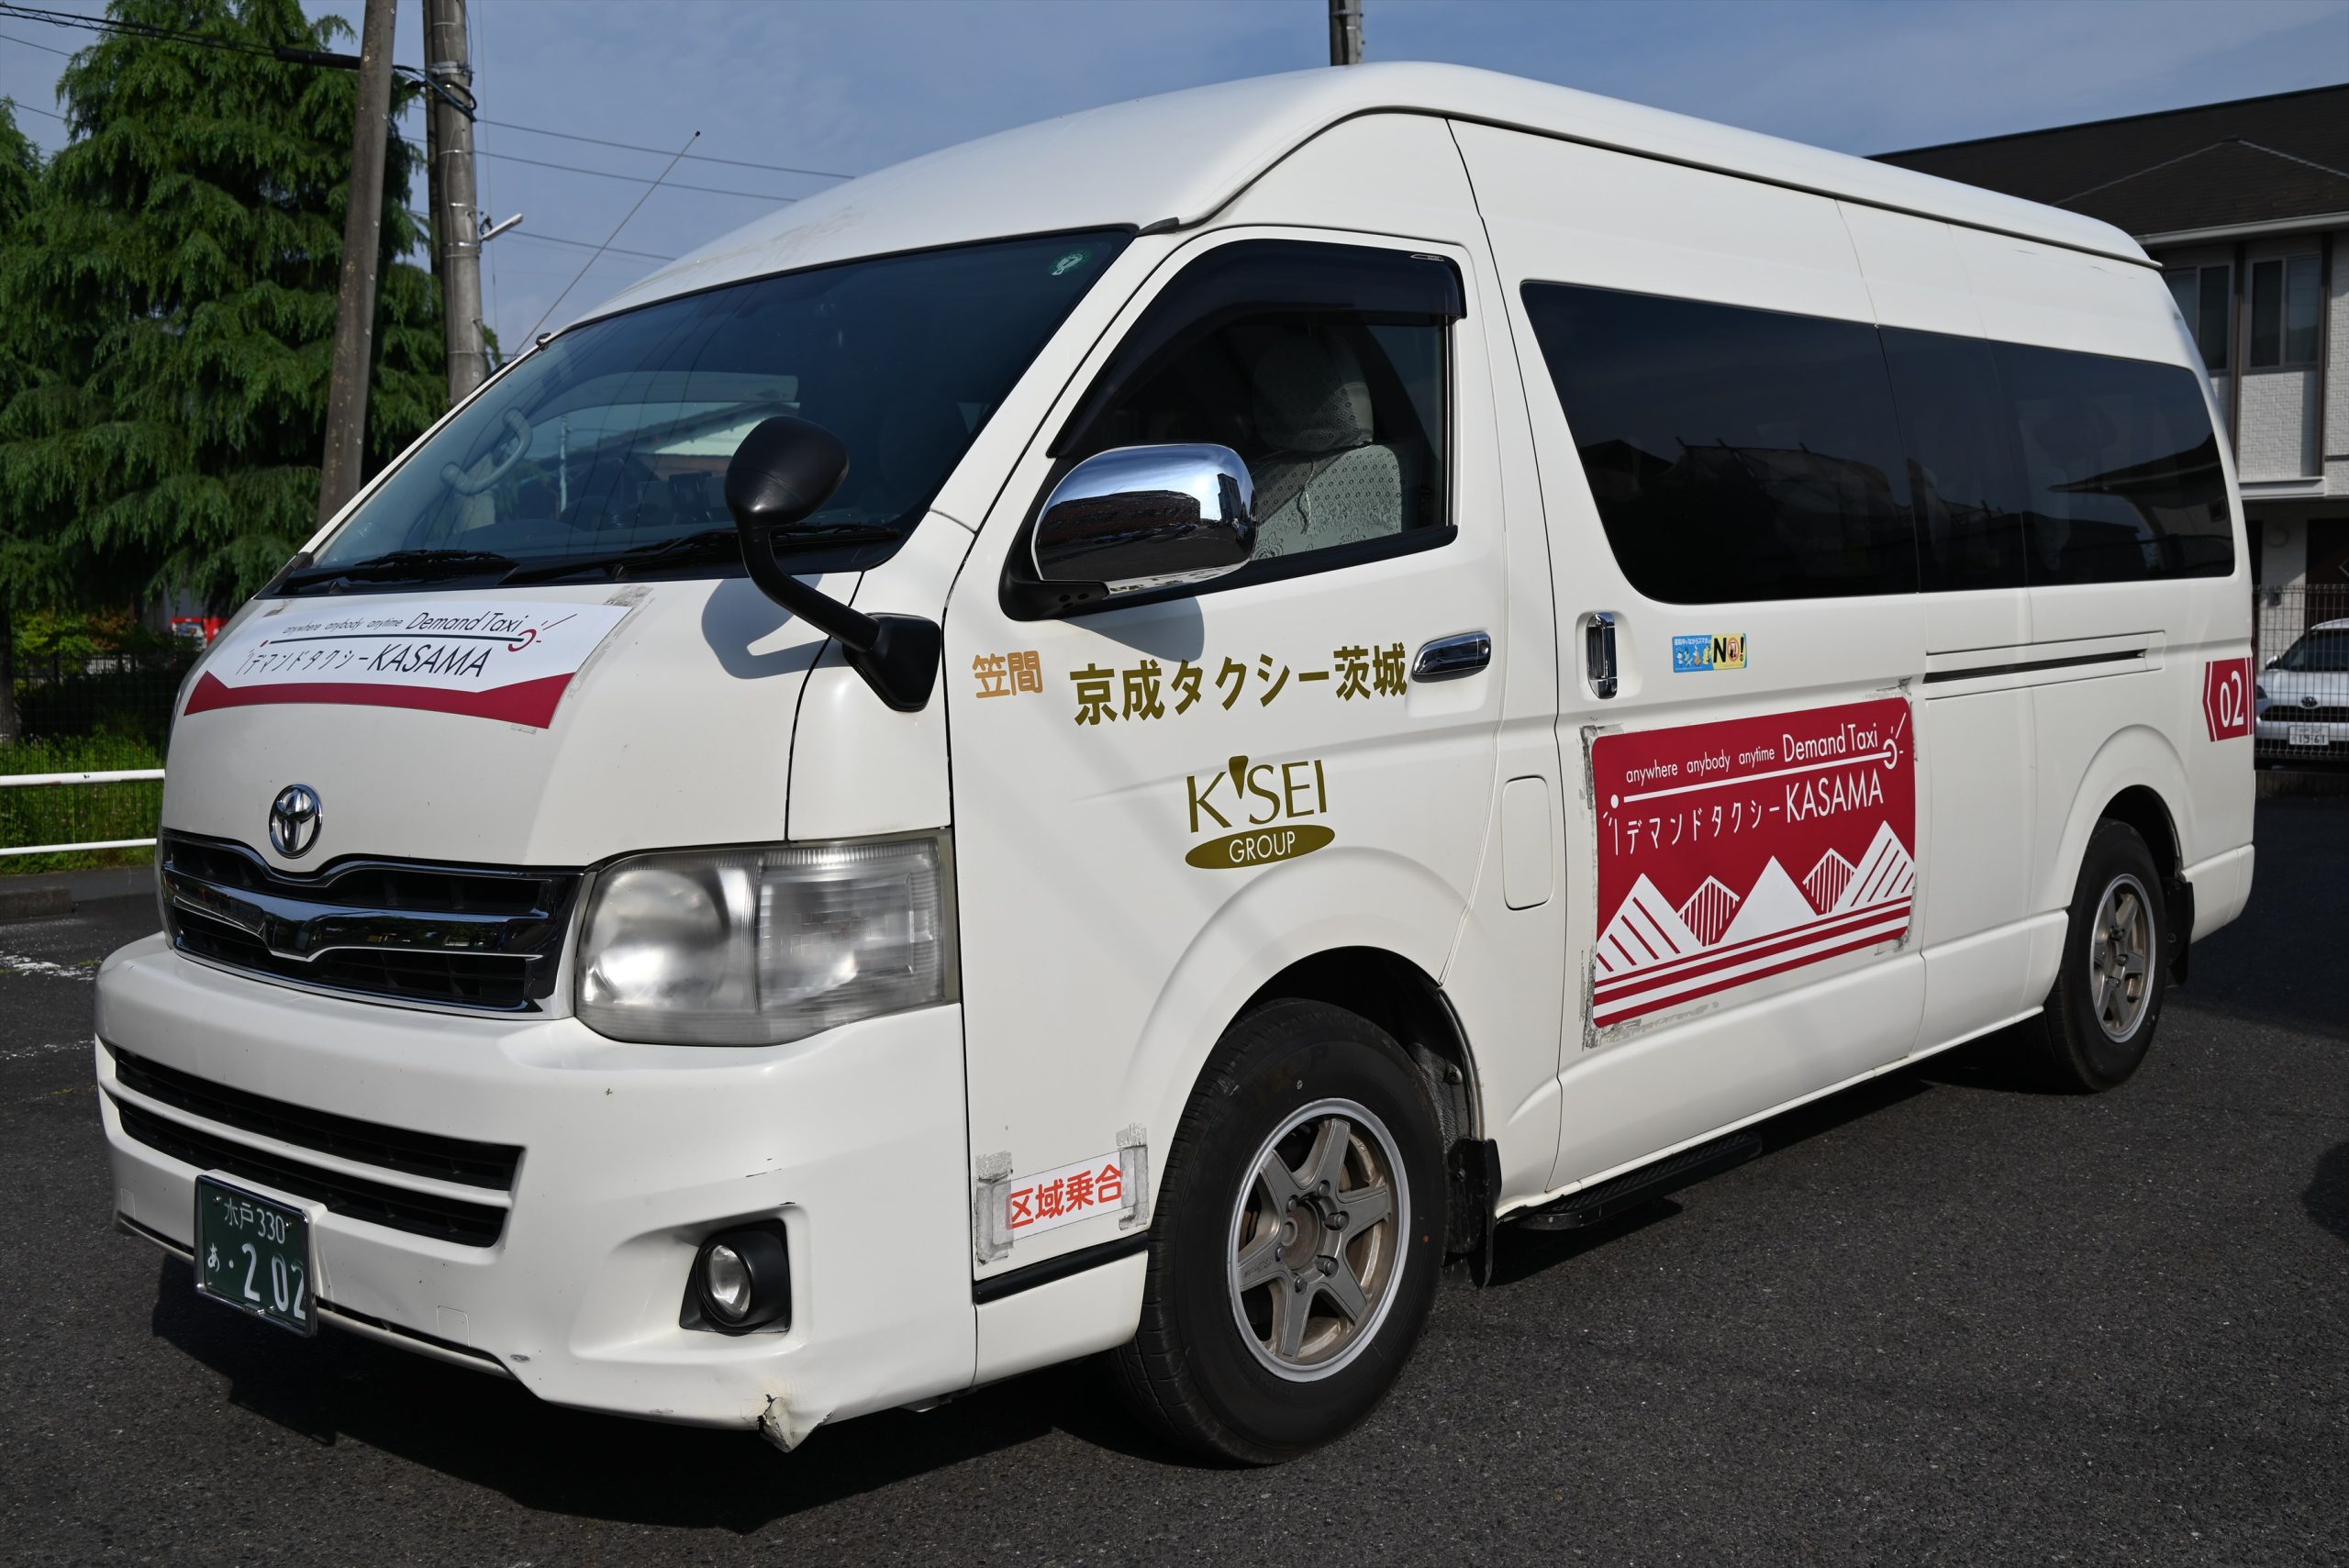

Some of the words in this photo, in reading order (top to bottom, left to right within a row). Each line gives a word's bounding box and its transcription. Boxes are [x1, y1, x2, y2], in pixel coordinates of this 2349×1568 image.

[283, 621, 322, 636] anywhere
[325, 617, 364, 632] anybody
[367, 617, 404, 630] anytime
[972, 651, 1043, 699] 笠間
[1069, 642, 1408, 727] 京成タクシー茨城
[2220, 670, 2244, 728] 02
[1626, 760, 1678, 786] anywhere
[1687, 750, 1731, 775] anybody
[1739, 746, 1776, 771] anytime
[1783, 725, 1846, 763] Demand
[1847, 723, 1878, 752] Taxi
[1786, 768, 1885, 823] KASAMA
[1229, 830, 1296, 863] GROUP
[1005, 1163, 1124, 1230] 区域乗合
